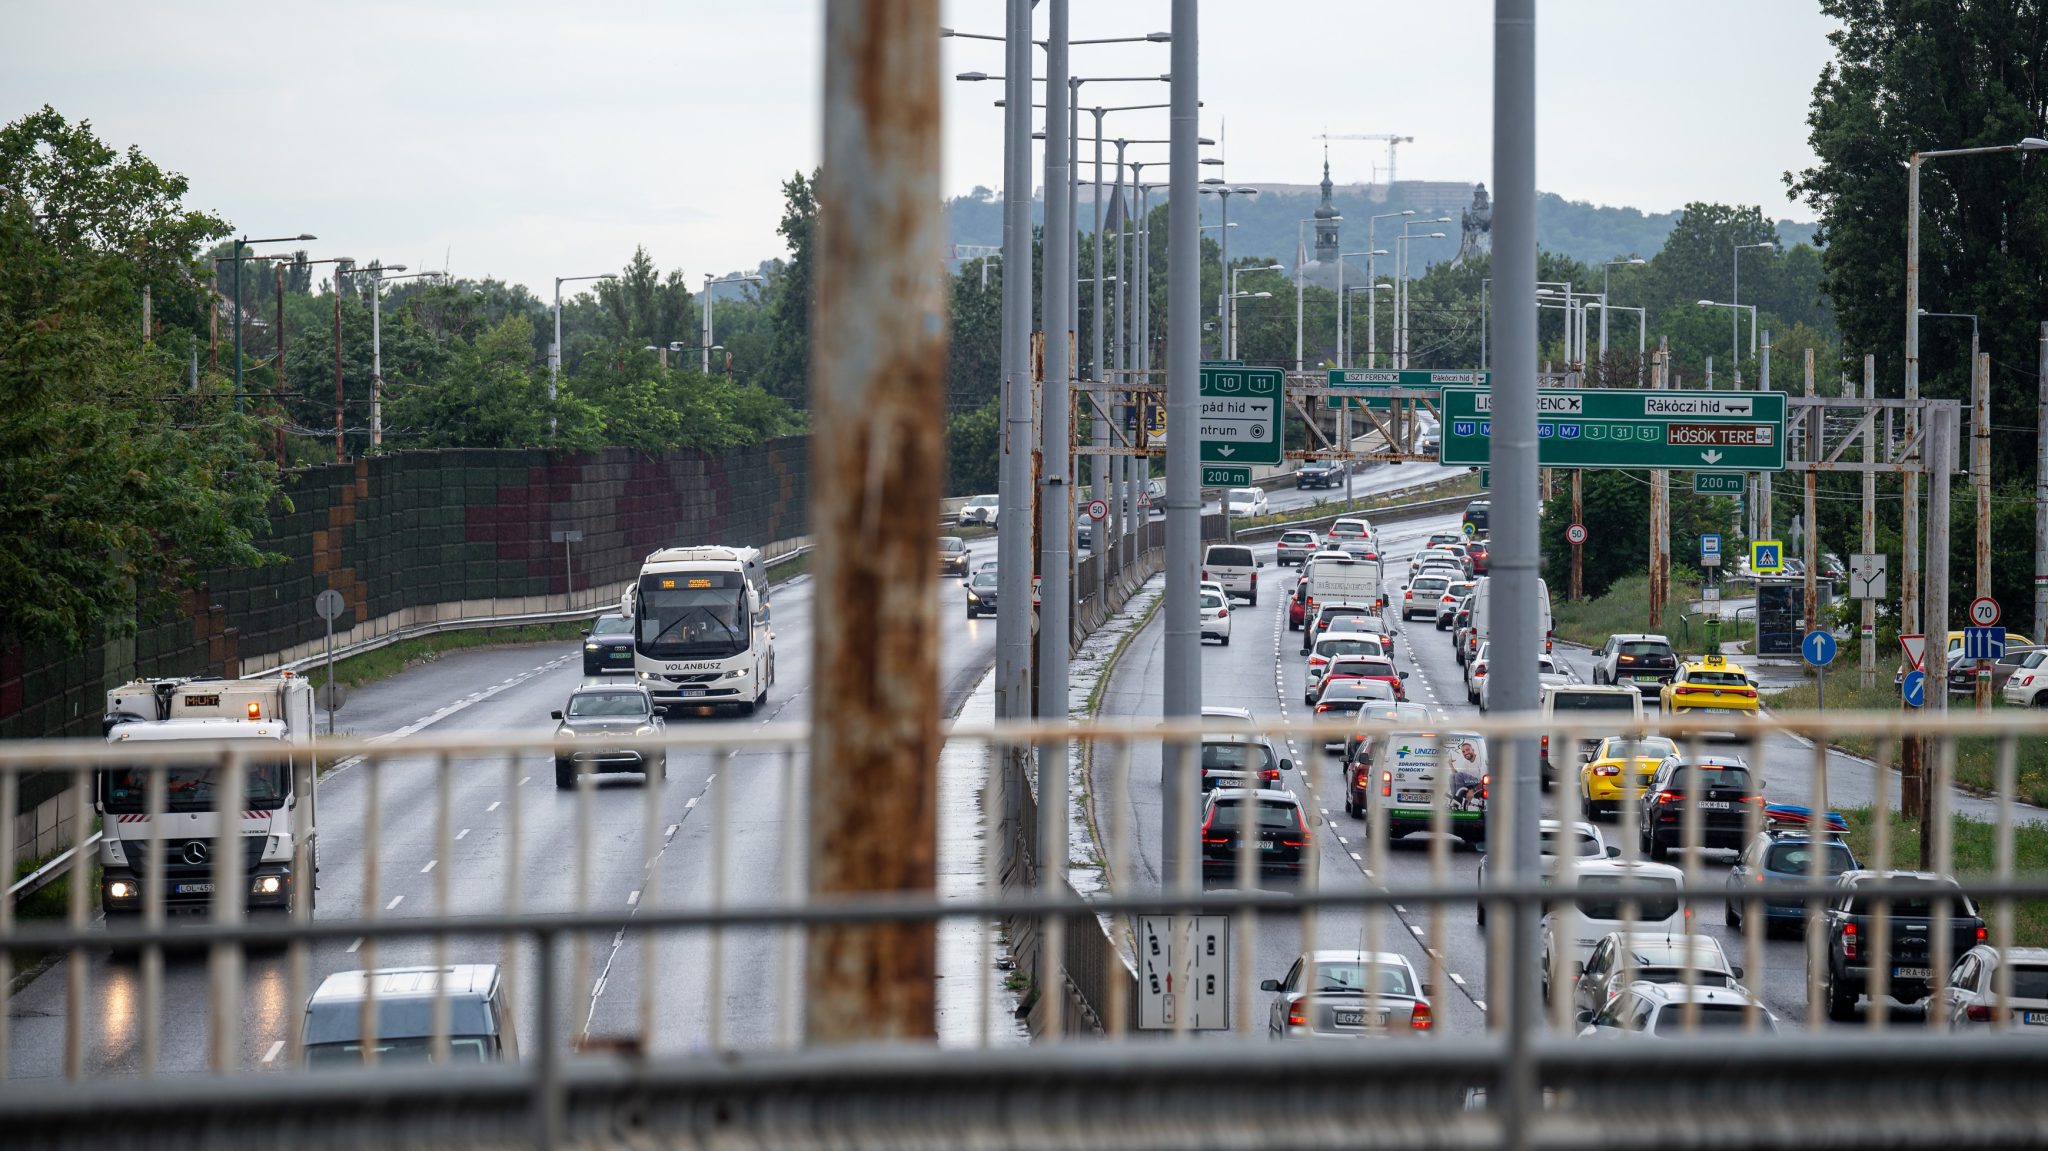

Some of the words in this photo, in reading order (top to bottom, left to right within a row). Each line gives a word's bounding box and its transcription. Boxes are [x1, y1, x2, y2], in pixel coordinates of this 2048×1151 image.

[1222, 377, 1234, 388] 10
[1257, 378, 1266, 389] 11
[1201, 402, 1224, 414] pád
[1477, 399, 1492, 409] LIS
[1537, 398, 1565, 410] RENC
[1647, 399, 1697, 412] Rákóczi
[1201, 425, 1237, 436] ntrum
[1458, 424, 1471, 433] M1
[1483, 424, 1491, 433] M
[1538, 425, 1550, 435] M6
[1561, 426, 1576, 436] M7
[1593, 427, 1599, 437] 3
[1617, 428, 1627, 437] 31
[1643, 428, 1654, 438] 51
[1721, 431, 1754, 444] TERE
[1208, 472, 1229, 482] 200
[1701, 478, 1723, 488] 200
[1092, 506, 1103, 514] 50
[1571, 530, 1582, 538] 50
[1977, 606, 1992, 618] 70
[179, 884, 214, 892] LOL-452
